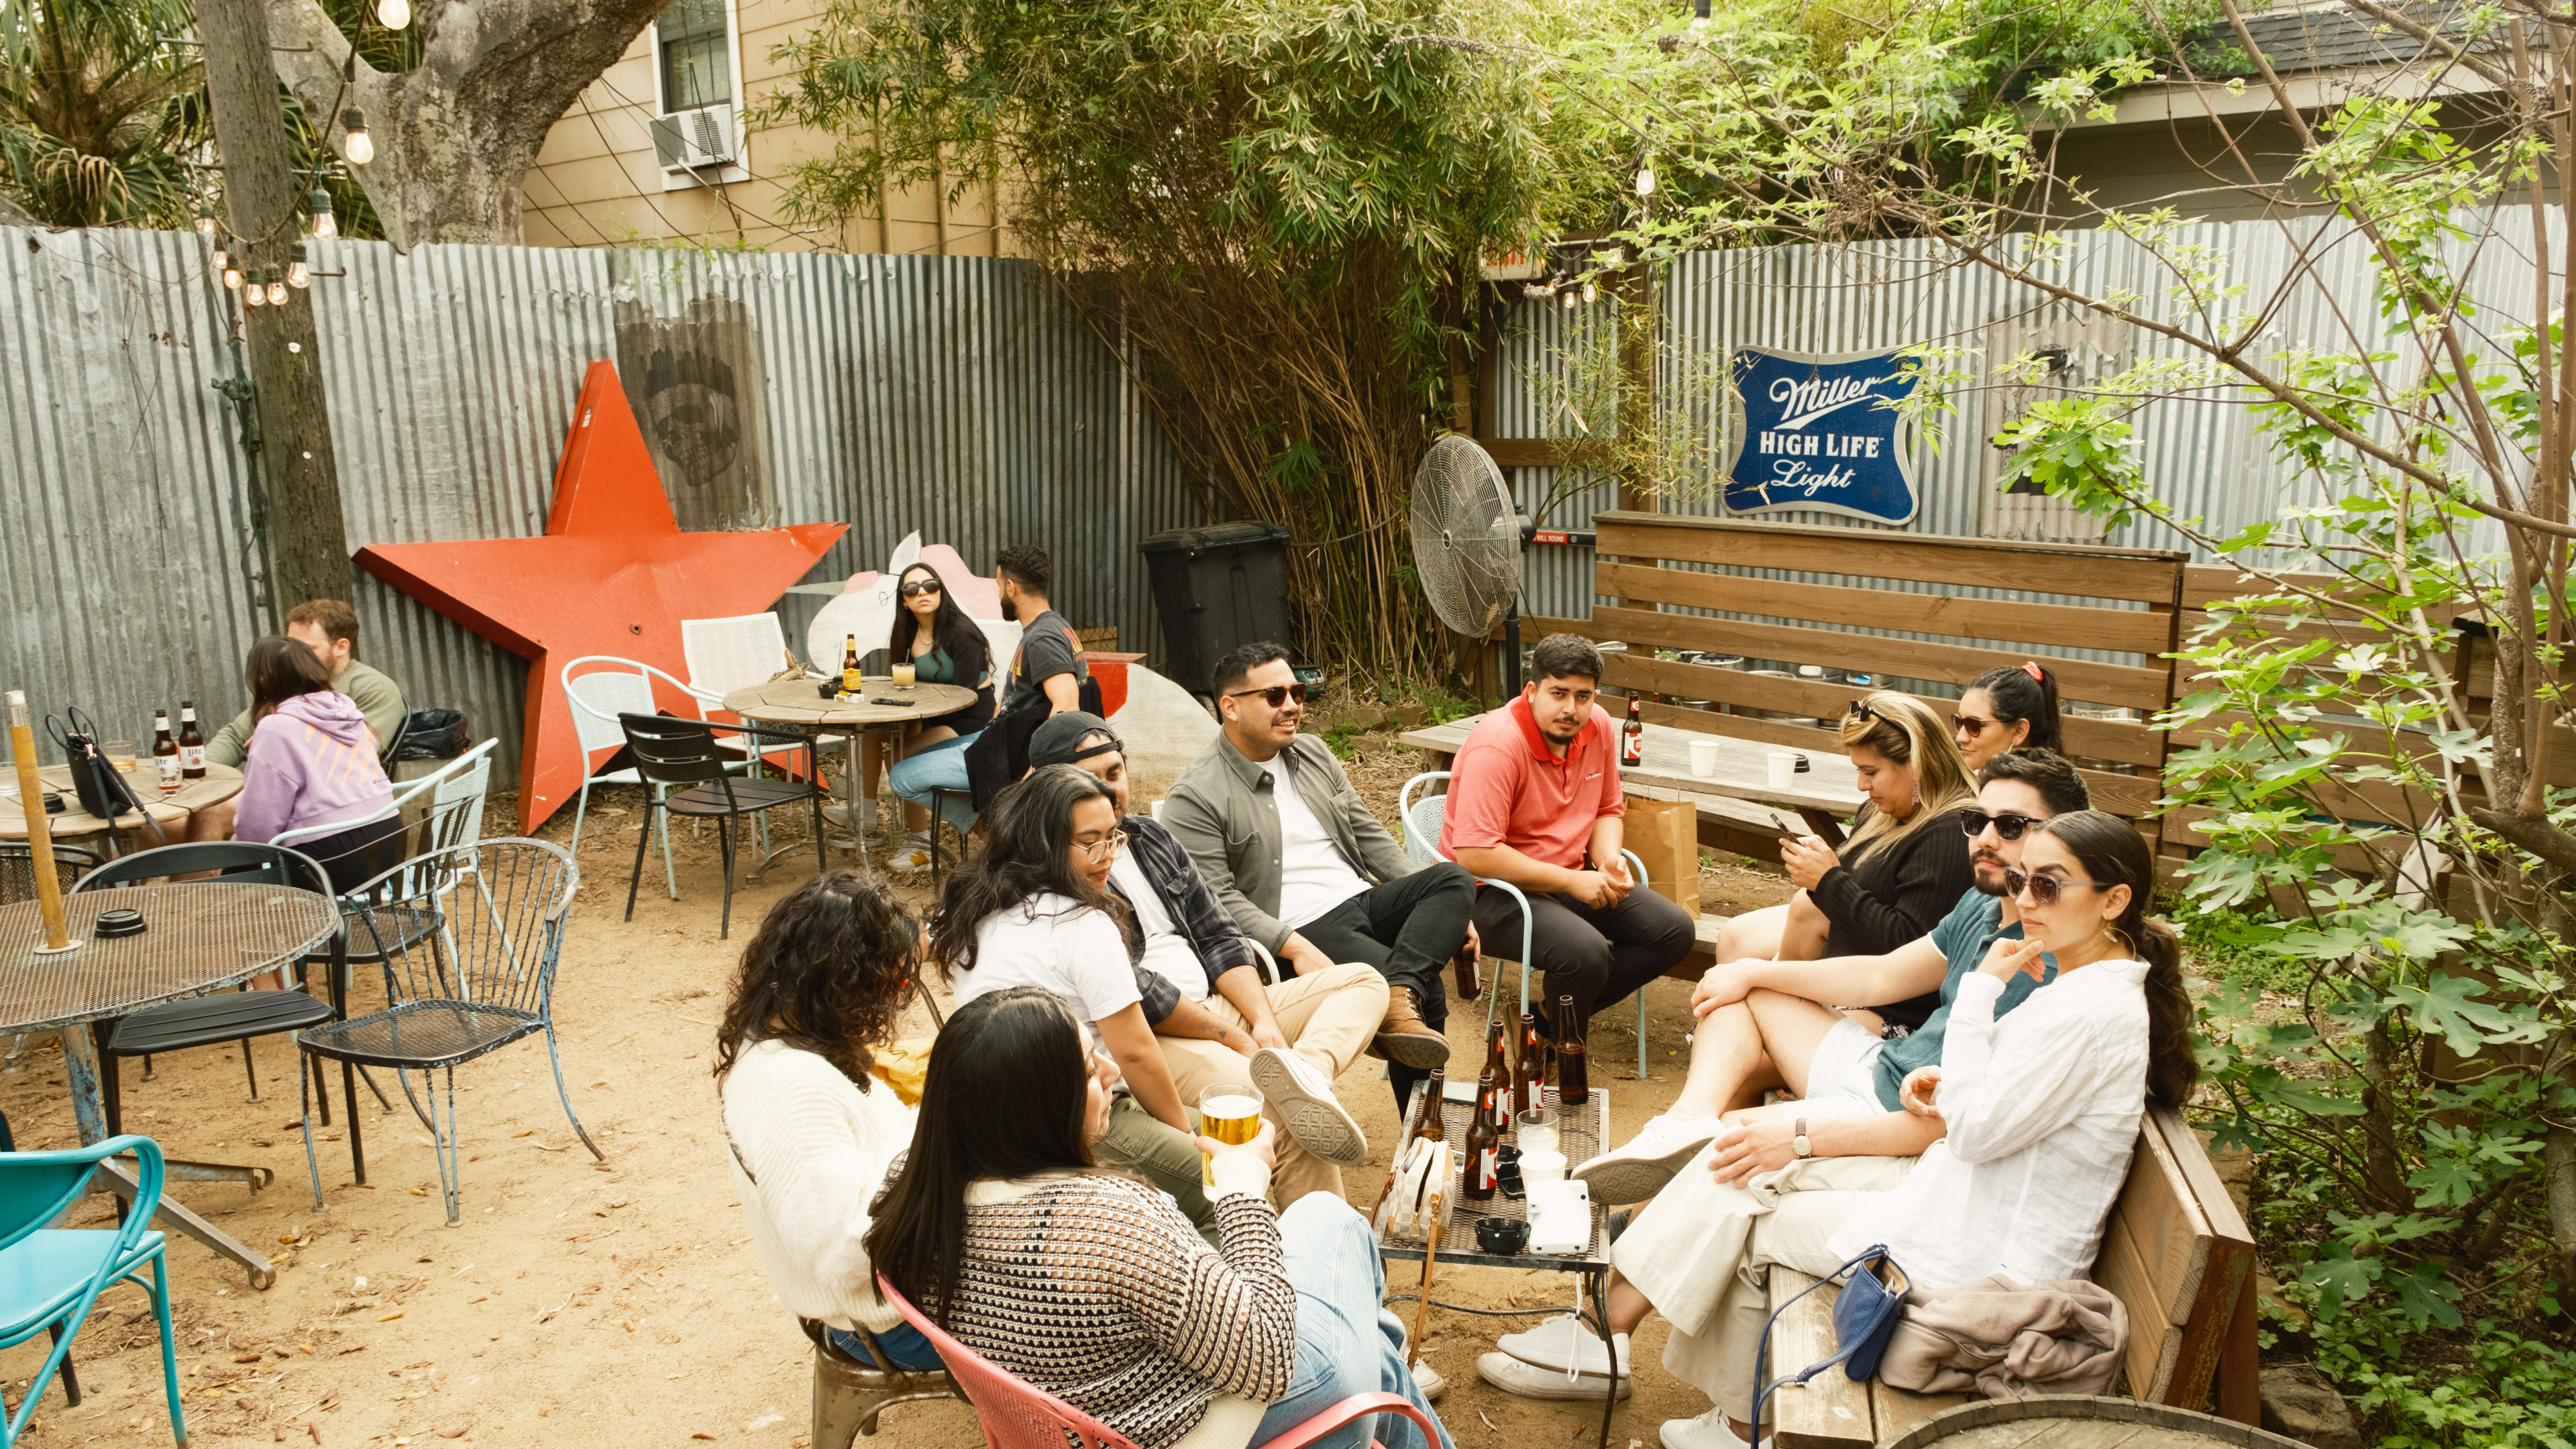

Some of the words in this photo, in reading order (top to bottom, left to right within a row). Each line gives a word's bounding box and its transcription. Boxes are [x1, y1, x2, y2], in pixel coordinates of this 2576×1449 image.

[1769, 376, 1881, 421] Miller
[1760, 431, 1819, 455] HIGH
[1770, 459, 1856, 496] Light
[188, 749, 202, 757] Lite
